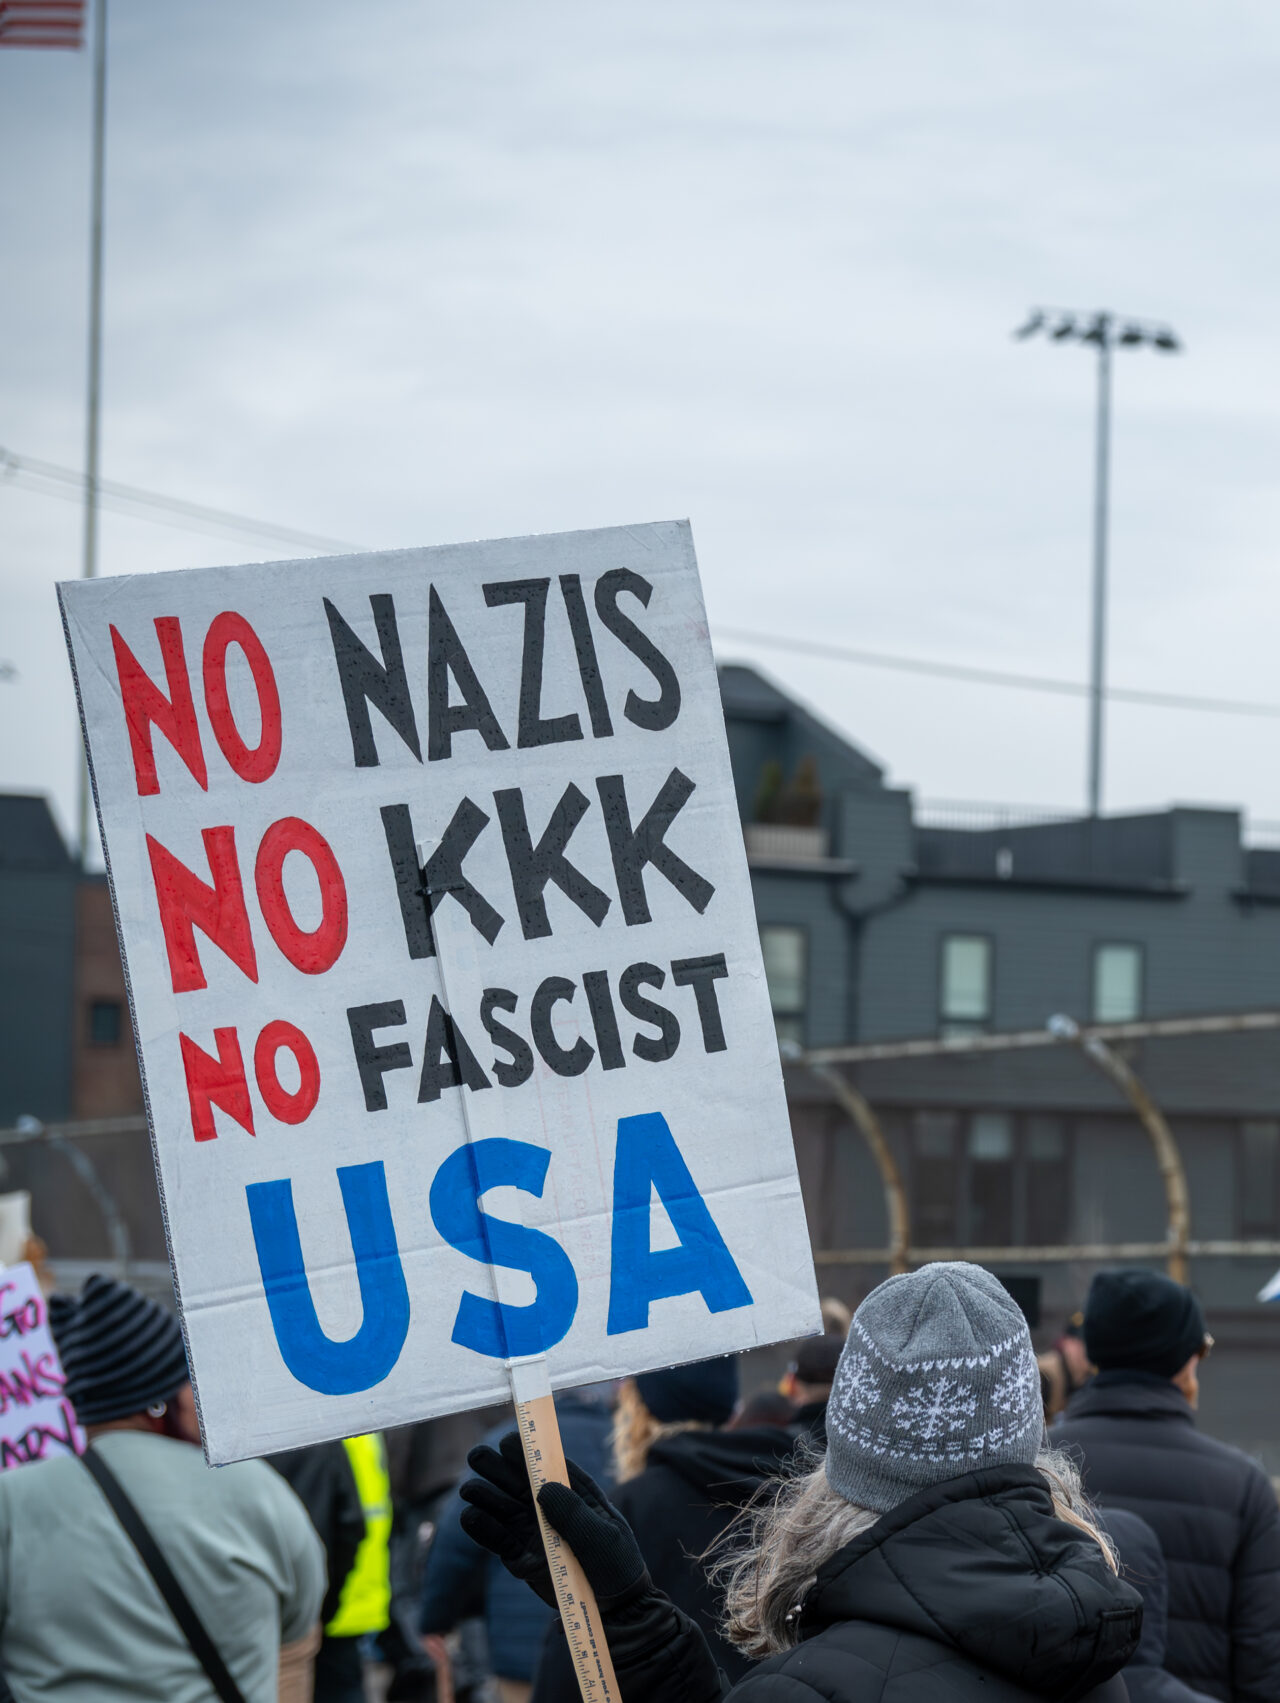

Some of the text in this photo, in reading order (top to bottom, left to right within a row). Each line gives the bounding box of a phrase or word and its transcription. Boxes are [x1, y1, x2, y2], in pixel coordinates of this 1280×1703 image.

[110, 566, 682, 797] NO NAZIS
[146, 767, 717, 994] NO KKK
[180, 953, 729, 1142] NO FASCIST
[246, 1111, 754, 1396] USA
[528, 1420, 536, 1433] 16
[534, 1449, 542, 1461] 15
[560, 1564, 568, 1577] 11
[567, 1593, 575, 1605] 10
